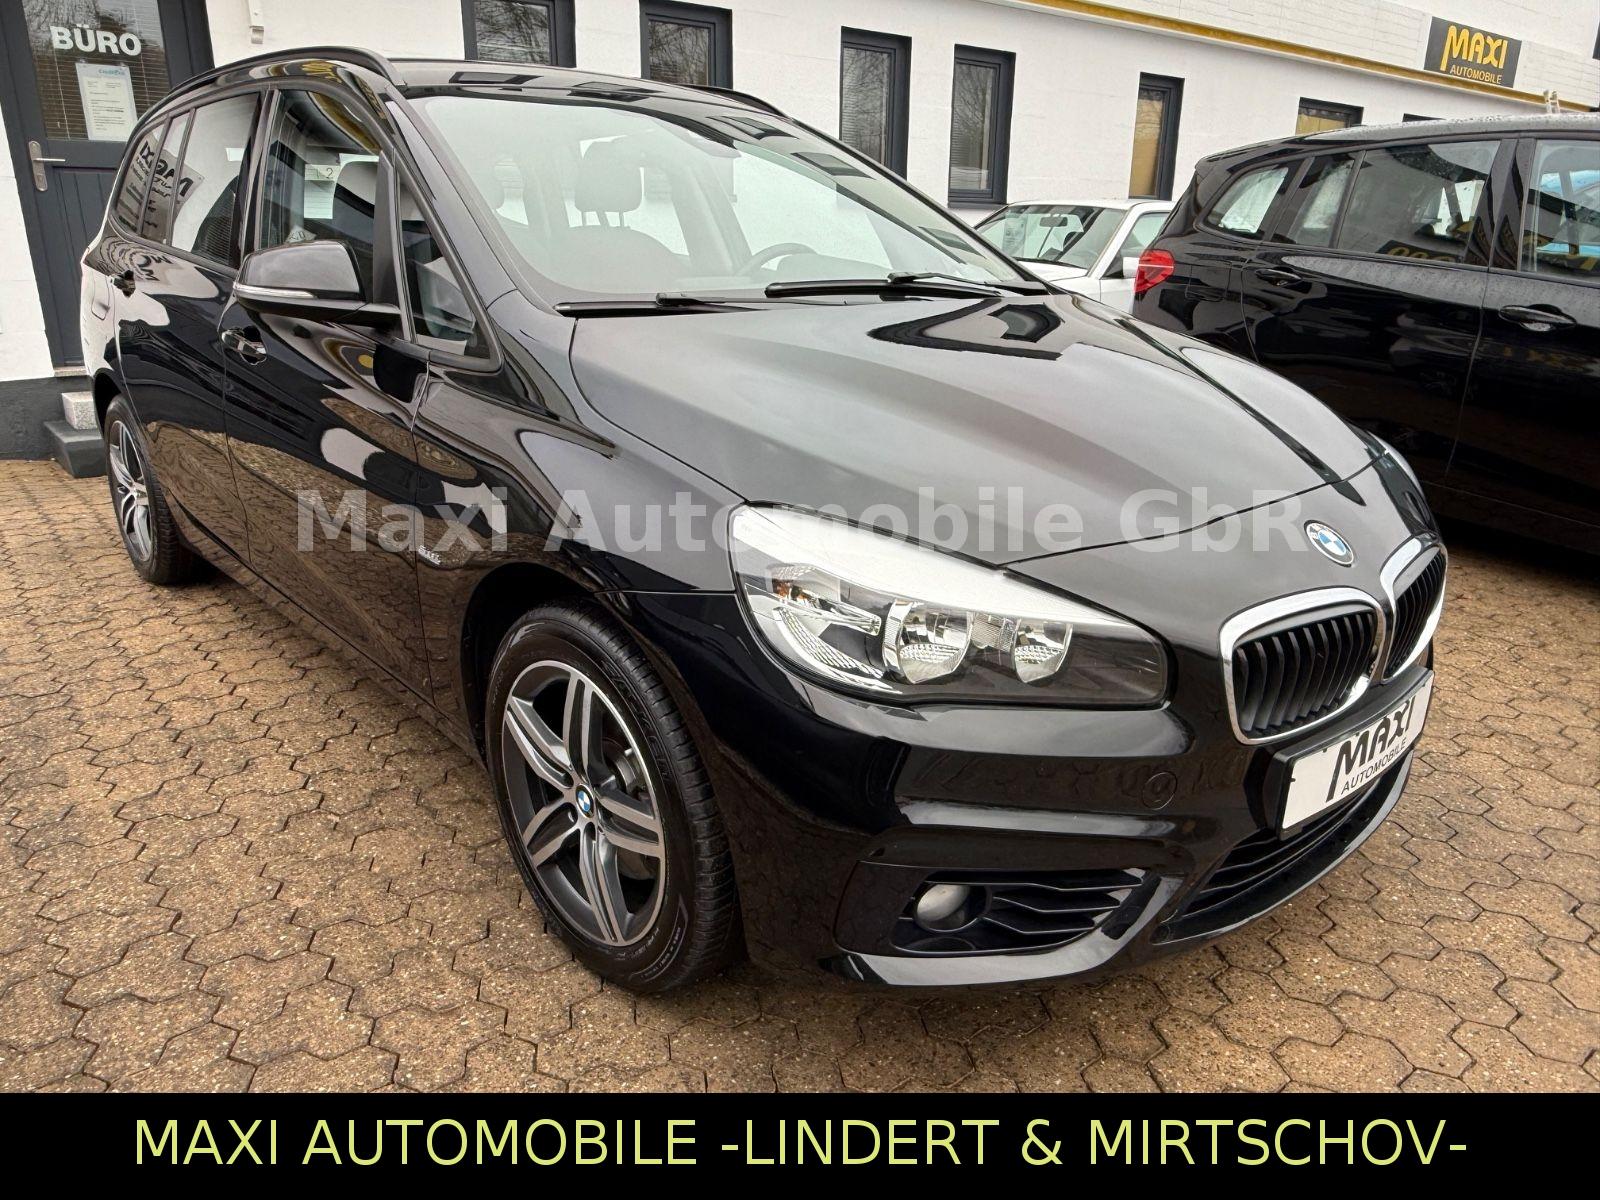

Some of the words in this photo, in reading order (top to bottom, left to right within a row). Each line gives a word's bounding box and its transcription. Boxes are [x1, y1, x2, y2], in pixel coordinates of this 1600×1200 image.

[49, 23, 142, 56] BÜRO
[1440, 25, 1509, 72] MAXI
[1449, 64, 1503, 85] AUTOMOBILE
[1326, 695, 1416, 802] MAXI
[1340, 737, 1407, 795] AUTOMOBILE
